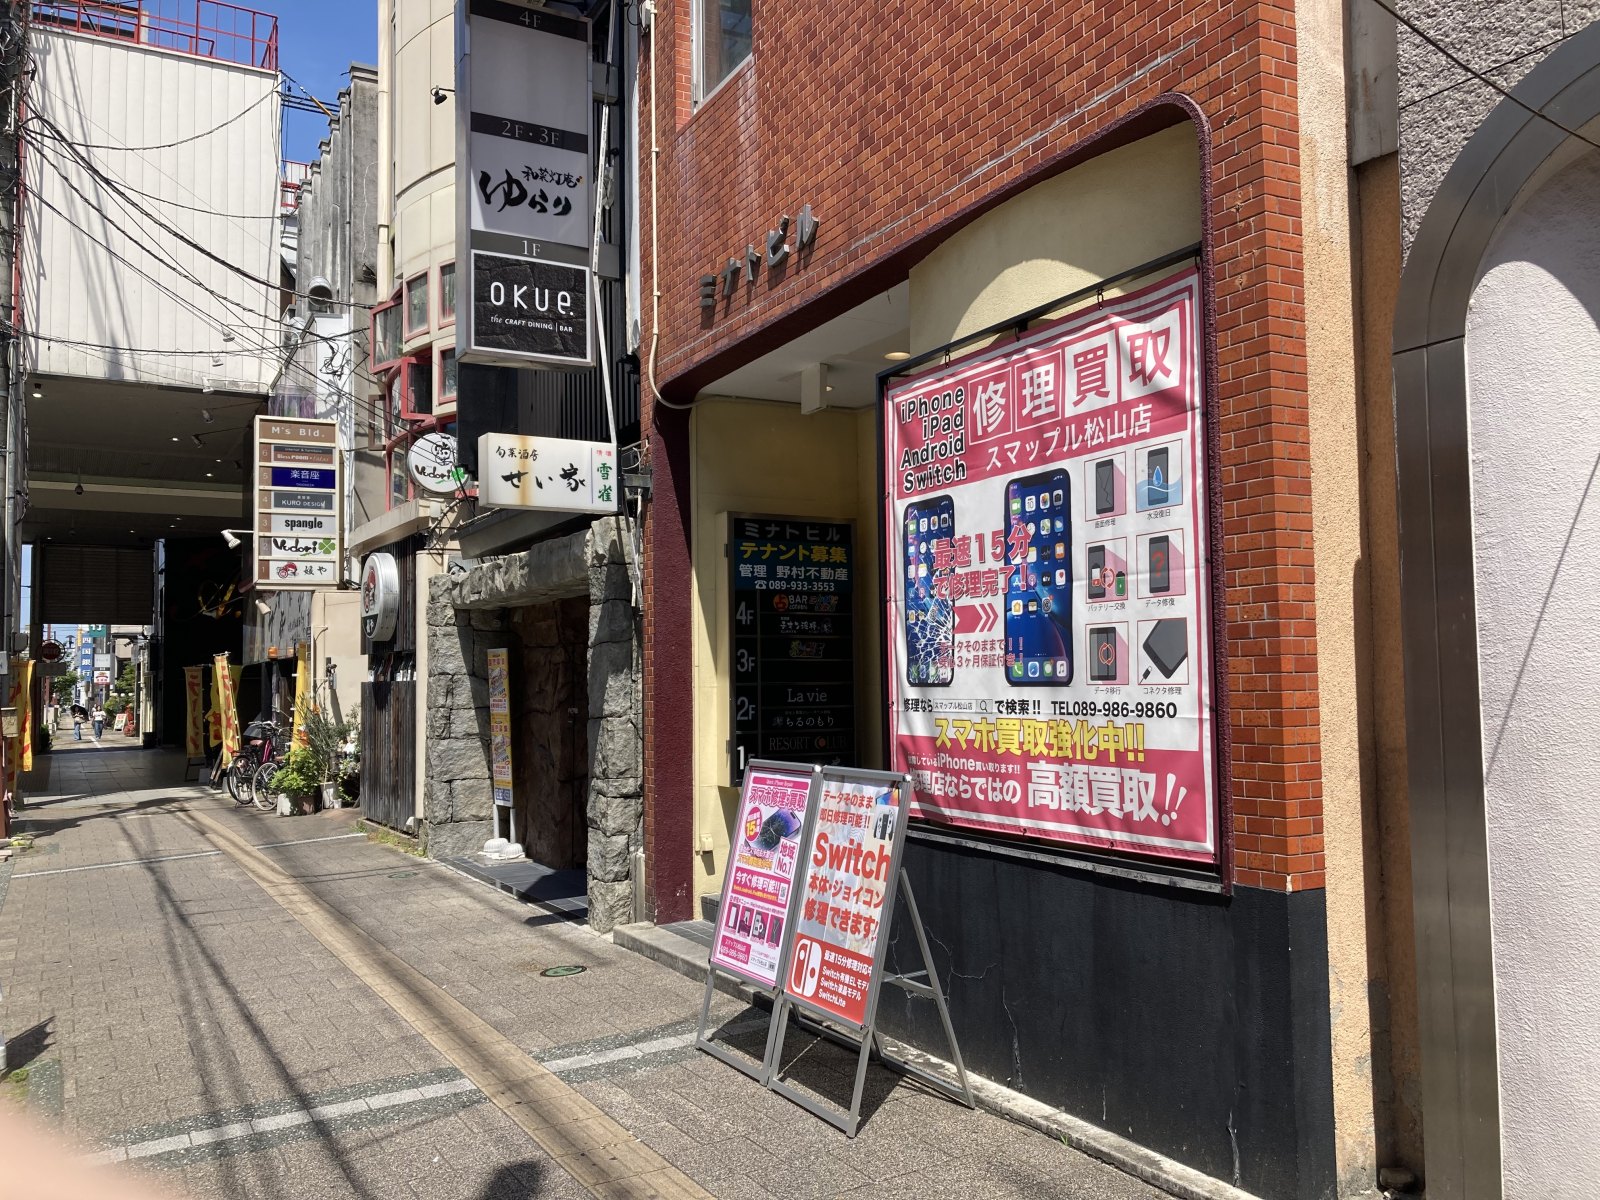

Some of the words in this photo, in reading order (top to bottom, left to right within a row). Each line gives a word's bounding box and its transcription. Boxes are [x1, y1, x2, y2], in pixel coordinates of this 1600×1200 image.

[519, 11, 541, 28] 4F
[479, 168, 572, 216] ゆらり
[522, 240, 541, 256] 1F
[699, 203, 819, 306] ミナトビル
[490, 314, 503, 324] the
[504, 318, 526, 327] CRAFT
[527, 321, 553, 331] DINING
[559, 325, 573, 333] BAR
[973, 326, 1172, 437] 修理買取
[901, 386, 965, 424] iPhone
[271, 426, 291, 435] M's
[299, 428, 326, 438] Bld.
[922, 405, 965, 440] iPad
[986, 402, 1153, 472] スマップル松山店
[900, 431, 965, 470] Android
[290, 469, 320, 480] 楽音座
[903, 457, 967, 493] Switch
[284, 516, 323, 531] spangle
[744, 521, 841, 542] ミナトビル
[740, 542, 848, 563] テナント募集
[932, 523, 1033, 570] 最速15分
[738, 563, 768, 578] 管理
[776, 565, 849, 581] 野村不動産
[768, 580, 835, 592] 089-933-3553
[736, 600, 755, 625] 4F
[788, 594, 808, 605] BAR
[736, 648, 756, 673] 3F
[1143, 687, 1182, 695] コネクタ修理
[736, 696, 756, 721] 2F
[787, 688, 804, 703] La
[806, 688, 828, 702] vie
[904, 698, 933, 713] 修理なら
[934, 716, 1146, 763] スマホ買取強化中!!
[823, 790, 874, 809] データそのまま
[812, 831, 891, 882] Switch
